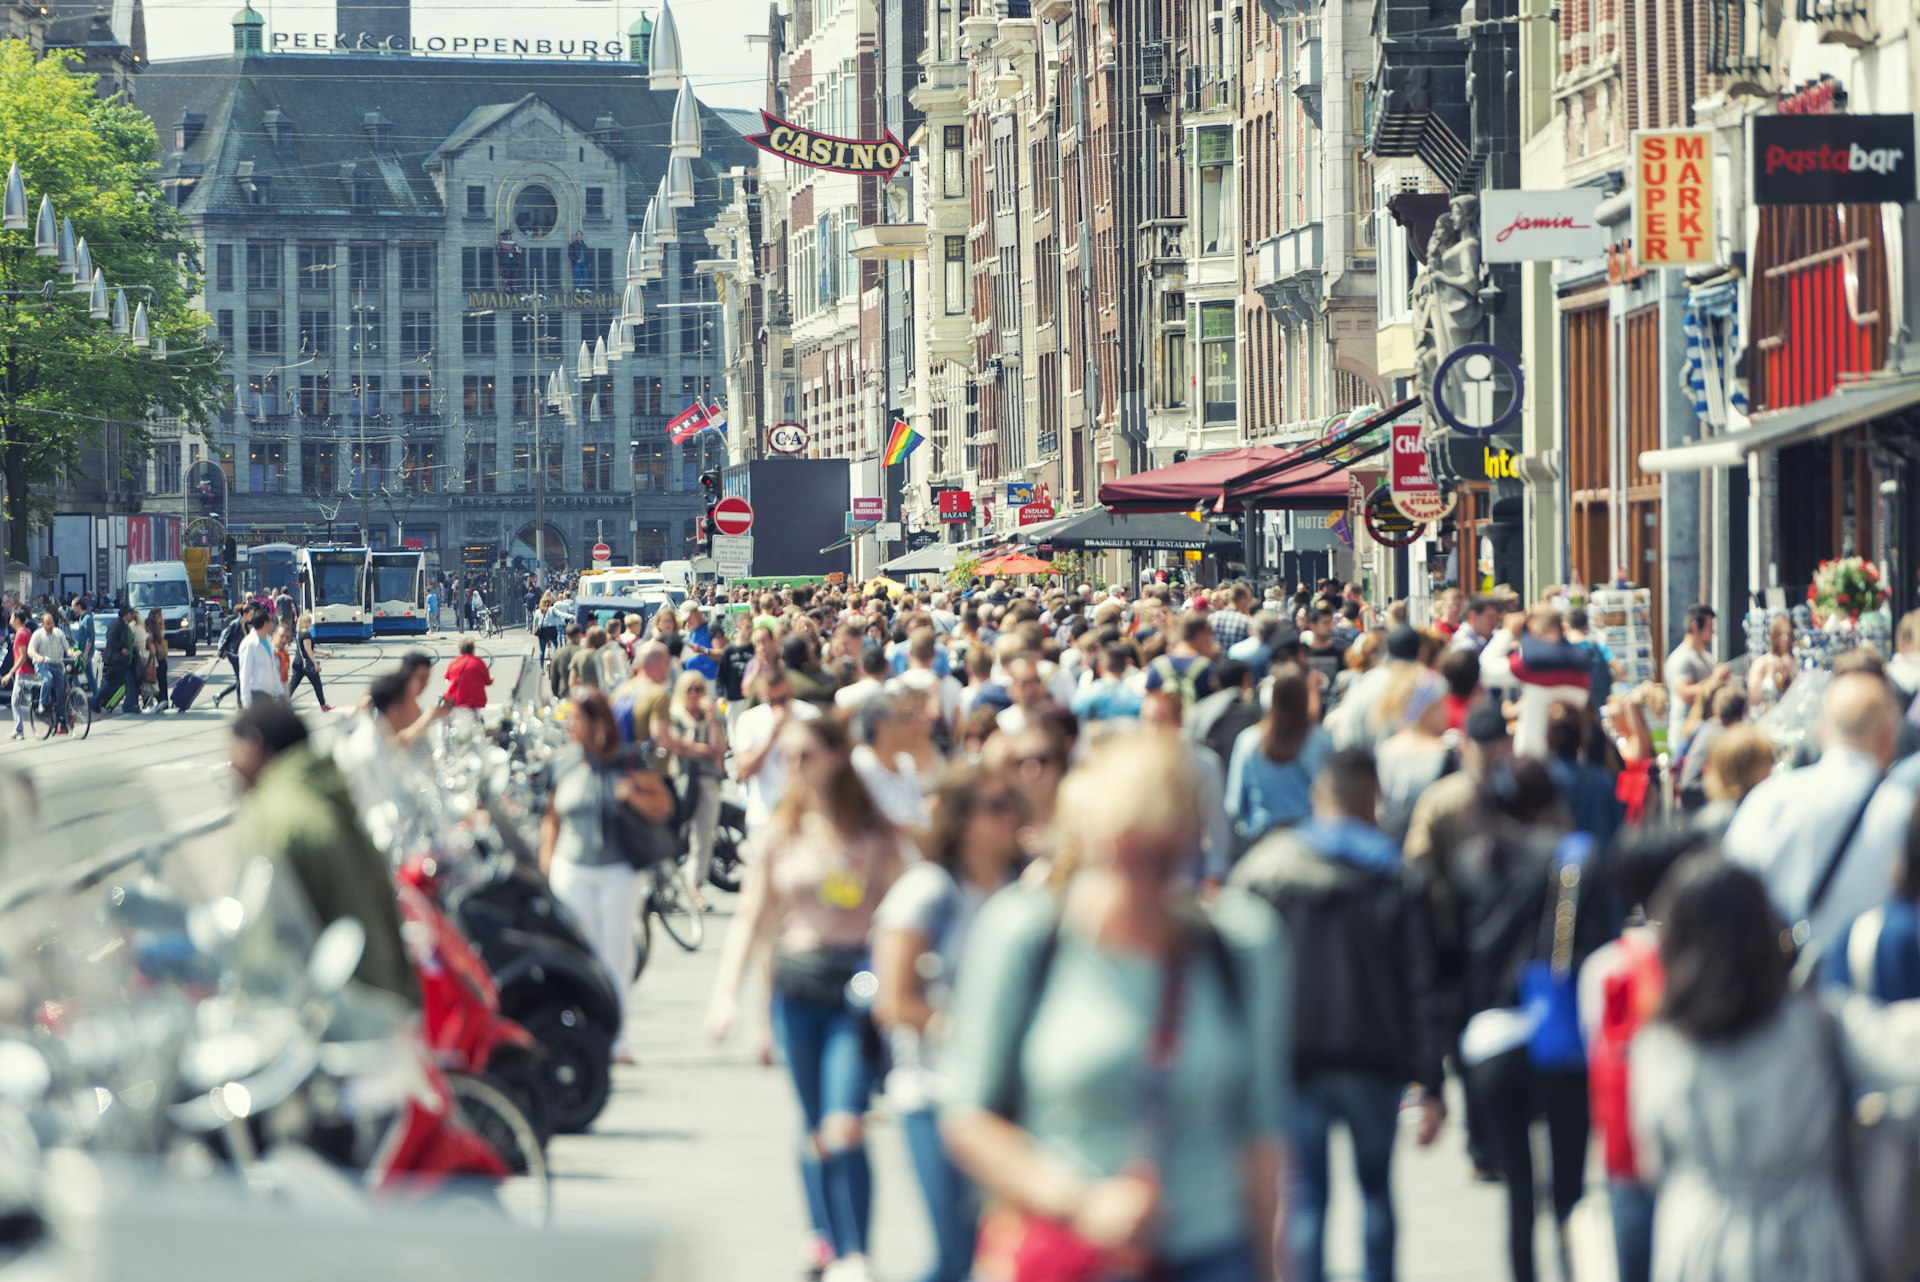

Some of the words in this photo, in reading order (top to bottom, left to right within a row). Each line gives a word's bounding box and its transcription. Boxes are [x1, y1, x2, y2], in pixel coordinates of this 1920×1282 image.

[272, 32, 351, 49] PEEK
[356, 31, 381, 50] &
[385, 34, 624, 55] CLOPPENBURG
[769, 126, 901, 169] CASINO
[1643, 137, 1669, 261] SUPER
[1675, 136, 1704, 260] MARKT
[1496, 211, 1591, 243] jamin
[775, 431, 803, 446] C&A
[1395, 435, 1426, 454] CHA
[1084, 539, 1124, 547] BRASSERIE
[1125, 539, 1131, 547] &
[1156, 540, 1206, 549] RESTAURANT
